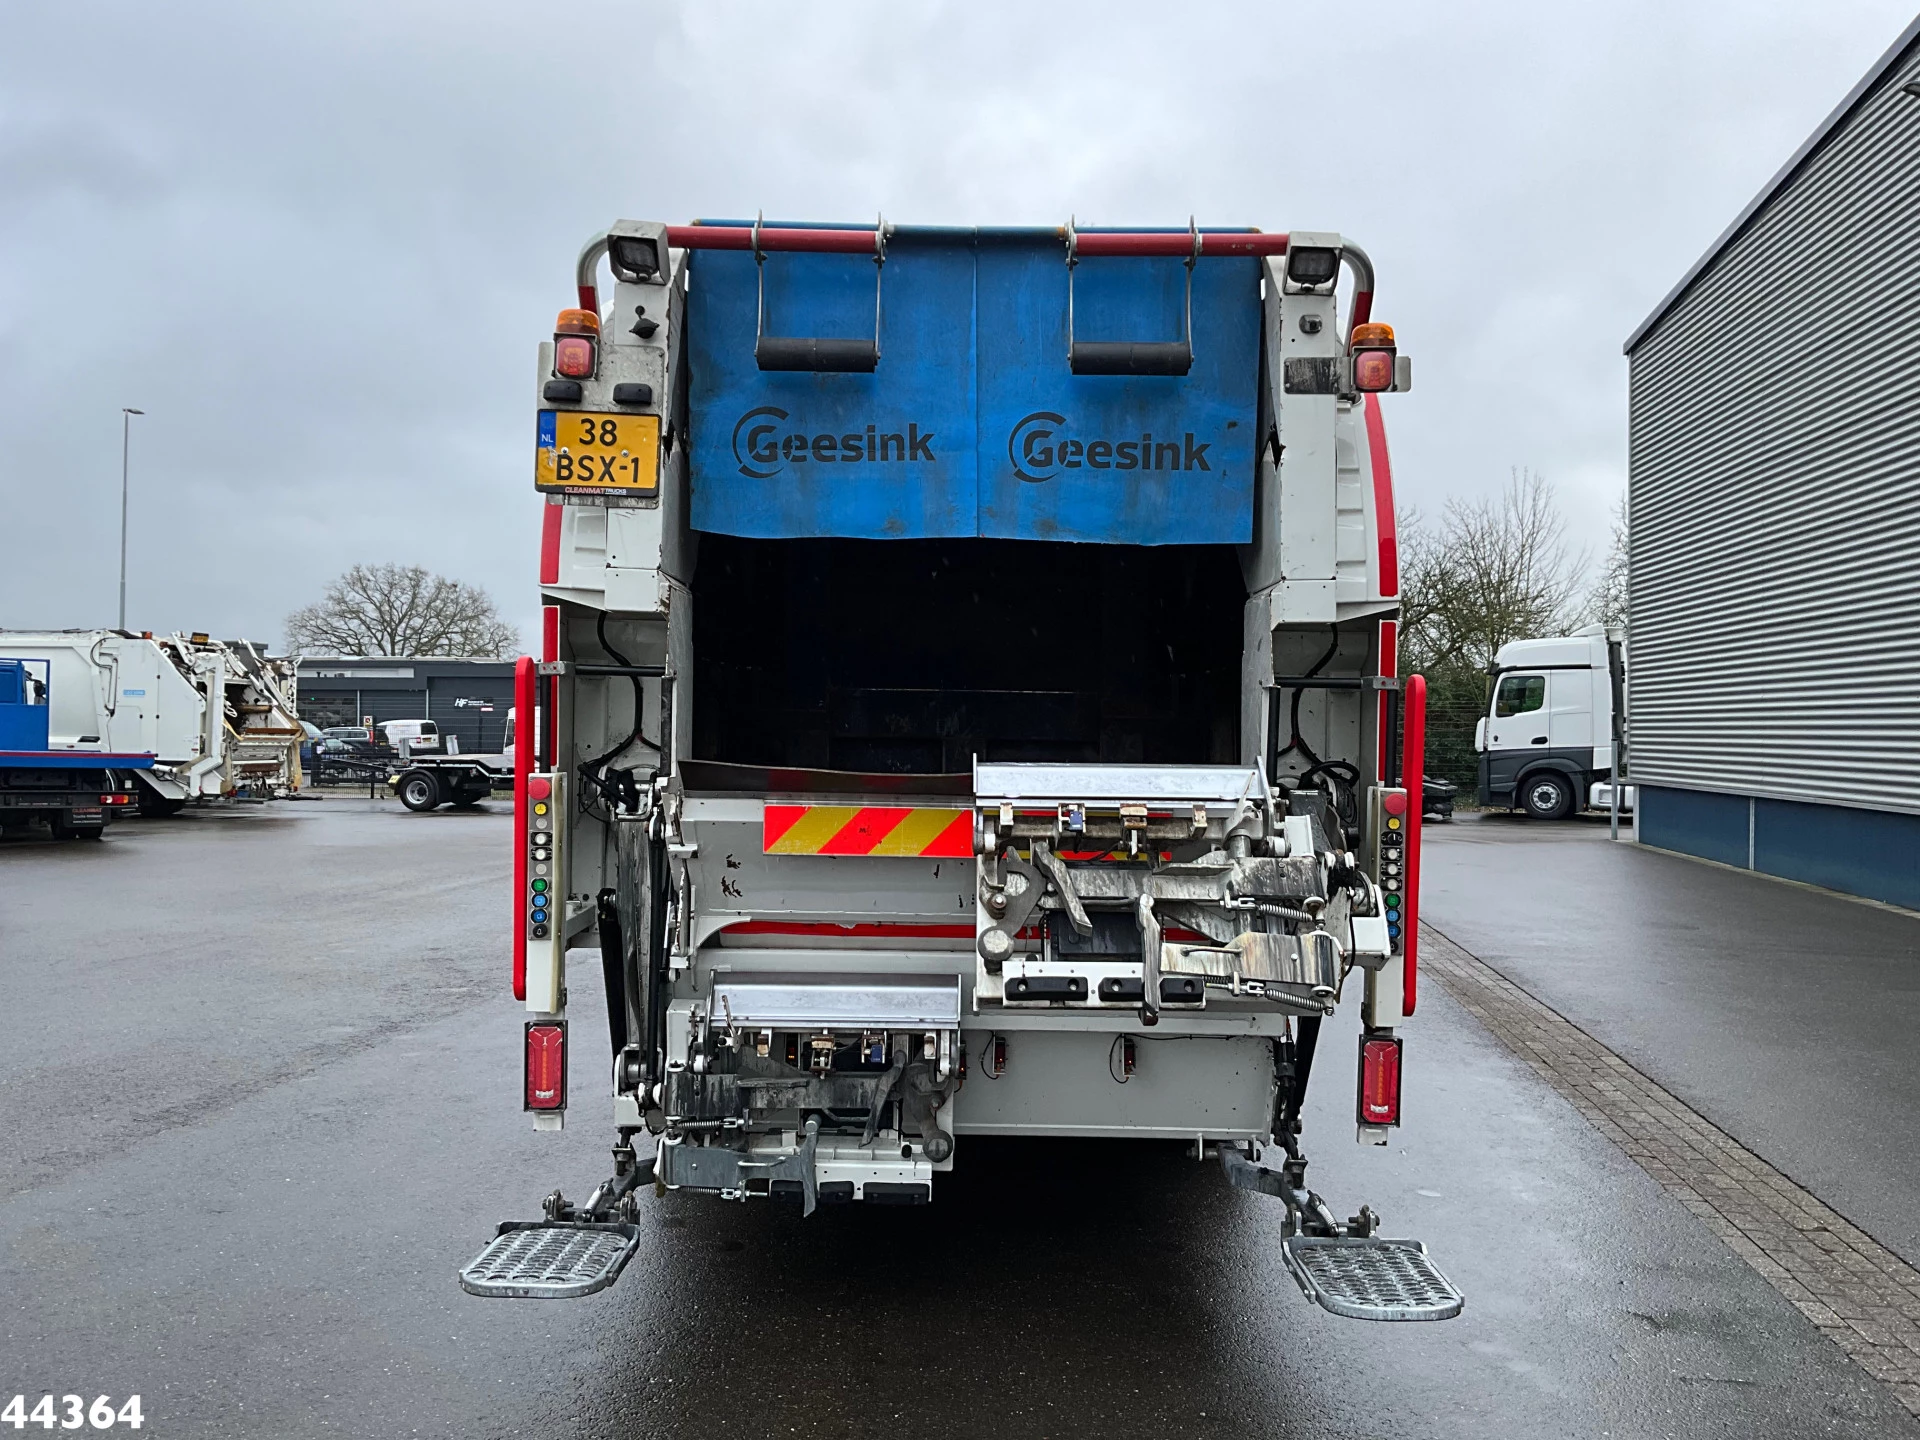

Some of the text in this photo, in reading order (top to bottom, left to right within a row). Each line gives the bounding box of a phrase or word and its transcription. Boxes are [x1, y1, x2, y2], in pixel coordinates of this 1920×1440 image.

[541, 433, 554, 443] NL
[579, 418, 617, 446] 38
[747, 421, 937, 463] Geesink
[1022, 429, 1212, 472] Geesink
[556, 454, 639, 484] BSX-1
[564, 486, 604, 494] CLEANMAT
